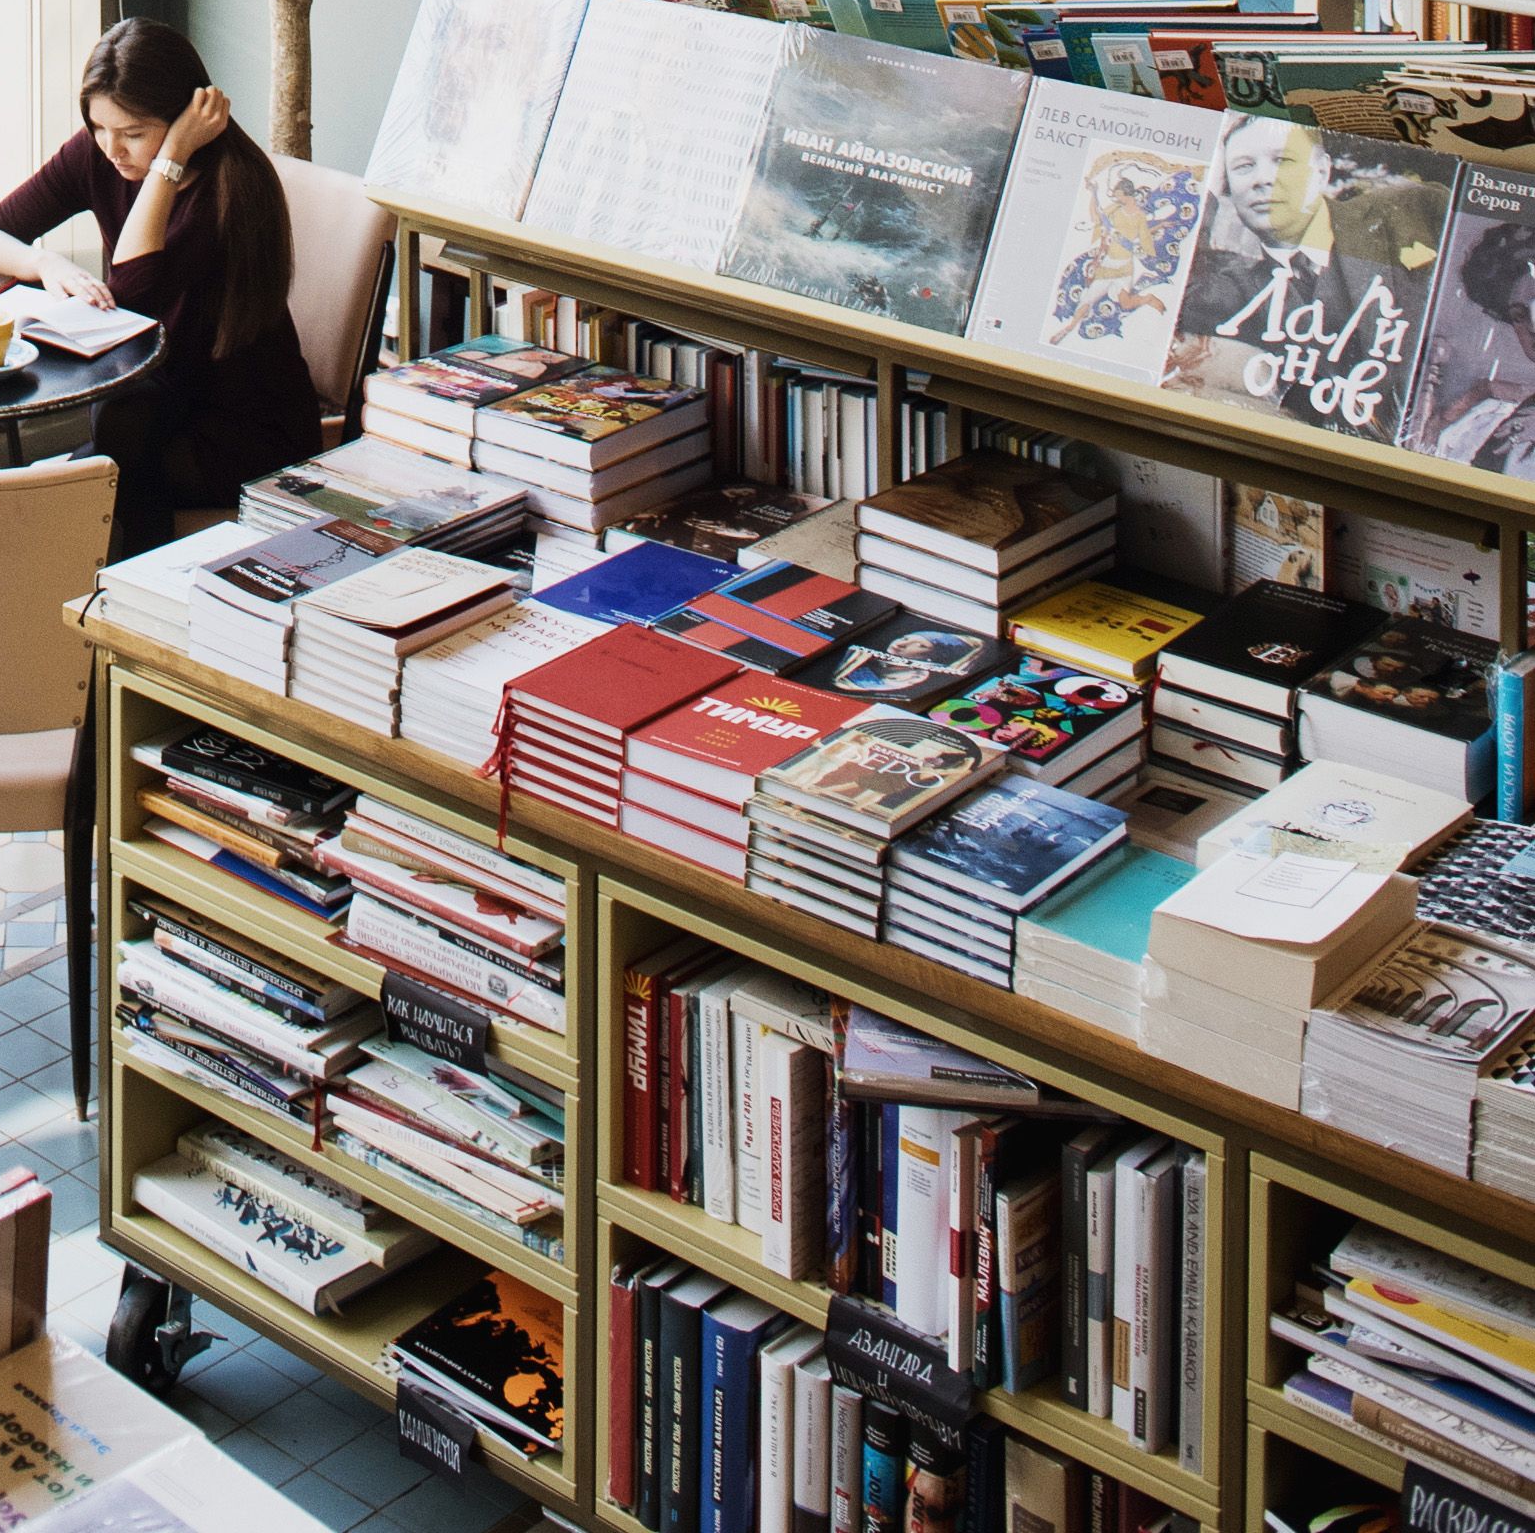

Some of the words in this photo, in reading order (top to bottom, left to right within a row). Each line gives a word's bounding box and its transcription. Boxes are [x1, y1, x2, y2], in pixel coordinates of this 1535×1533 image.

[1034, 126, 1087, 150] БАКСТ
[1038, 105, 1071, 124] ЛЕВ
[1075, 114, 1203, 152] САМОЙЛОВИЧ
[782, 127, 835, 153] ИВАН
[835, 140, 974, 187] АЙВАЗОВСКИЙ
[800, 151, 865, 176] ВЕЛИКИЙ
[867, 168, 946, 195] МАРИНИСТ
[1467, 187, 1522, 214] Серов
[1470, 169, 1535, 200] Валент
[485, 619, 556, 652] МУЗЕЕМ
[691, 696, 821, 740] ТИМУР
[1502, 712, 1517, 758] МОРЯ
[952, 792, 1005, 823] Питер
[972, 787, 1039, 832] Брейгель
[1500, 760, 1517, 823] КРАСКИ
[387, 993, 410, 1021] КАК
[413, 1004, 474, 1046] НАУЧИТЬСЯ
[626, 1003, 648, 1093] ТИМУР
[770, 1099, 783, 1176] ХАРДЖИЕВА
[772, 1176, 783, 1222] АРХИВ
[1187, 1184, 1201, 1215] ILYA
[1186, 1219, 1199, 1256] AND
[976, 1224, 994, 1304] МАЛЕВИЧ
[1185, 1259, 1199, 1311] EMILIA
[846, 1327, 935, 1386] АВАНГАРД
[1183, 1315, 1198, 1393] KABAKOV
[714, 1389, 725, 1447] АВАНГАРД
[398, 1408, 462, 1476] КАЛЛИГРАФИЯ
[713, 1448, 724, 1502] РУССКИЙ
